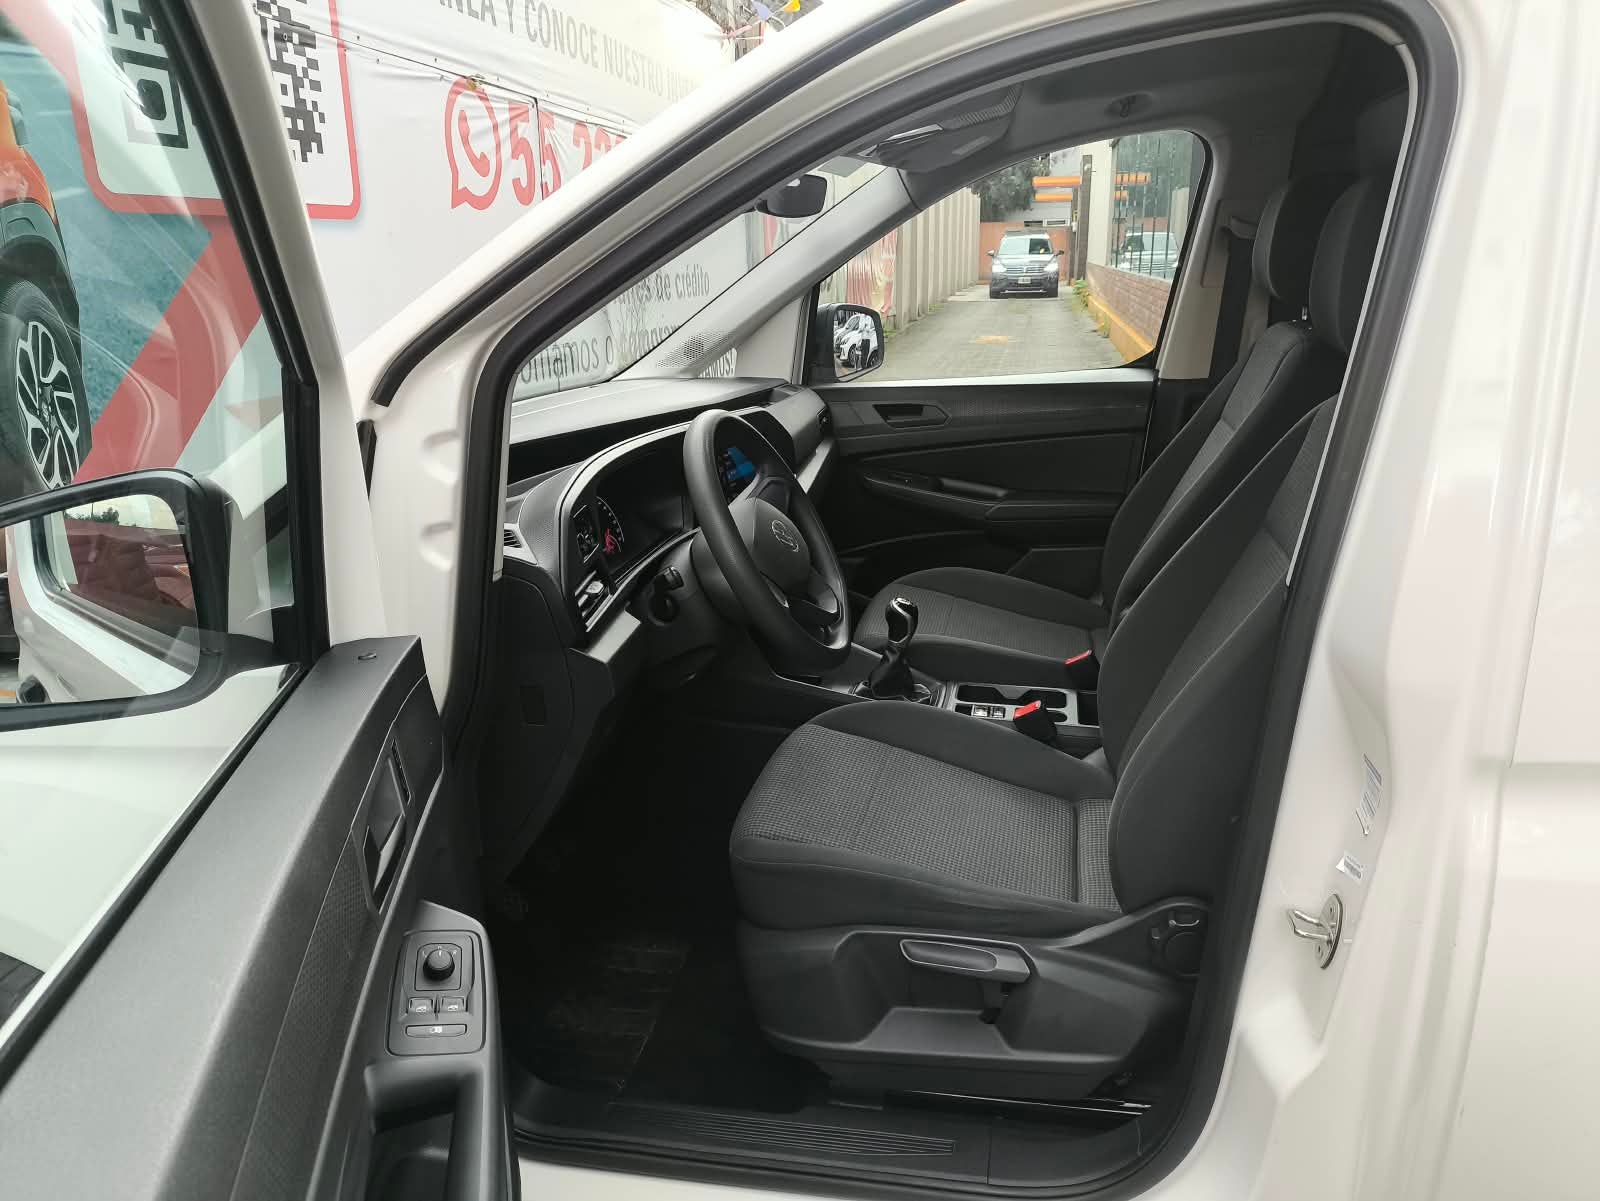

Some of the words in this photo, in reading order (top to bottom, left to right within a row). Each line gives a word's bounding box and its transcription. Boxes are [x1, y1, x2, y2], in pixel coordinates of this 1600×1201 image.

[524, 0, 599, 69] CONOCE
[603, 34, 663, 97] NUESTRO
[675, 263, 710, 299] crédito
[520, 337, 600, 384] omamos
